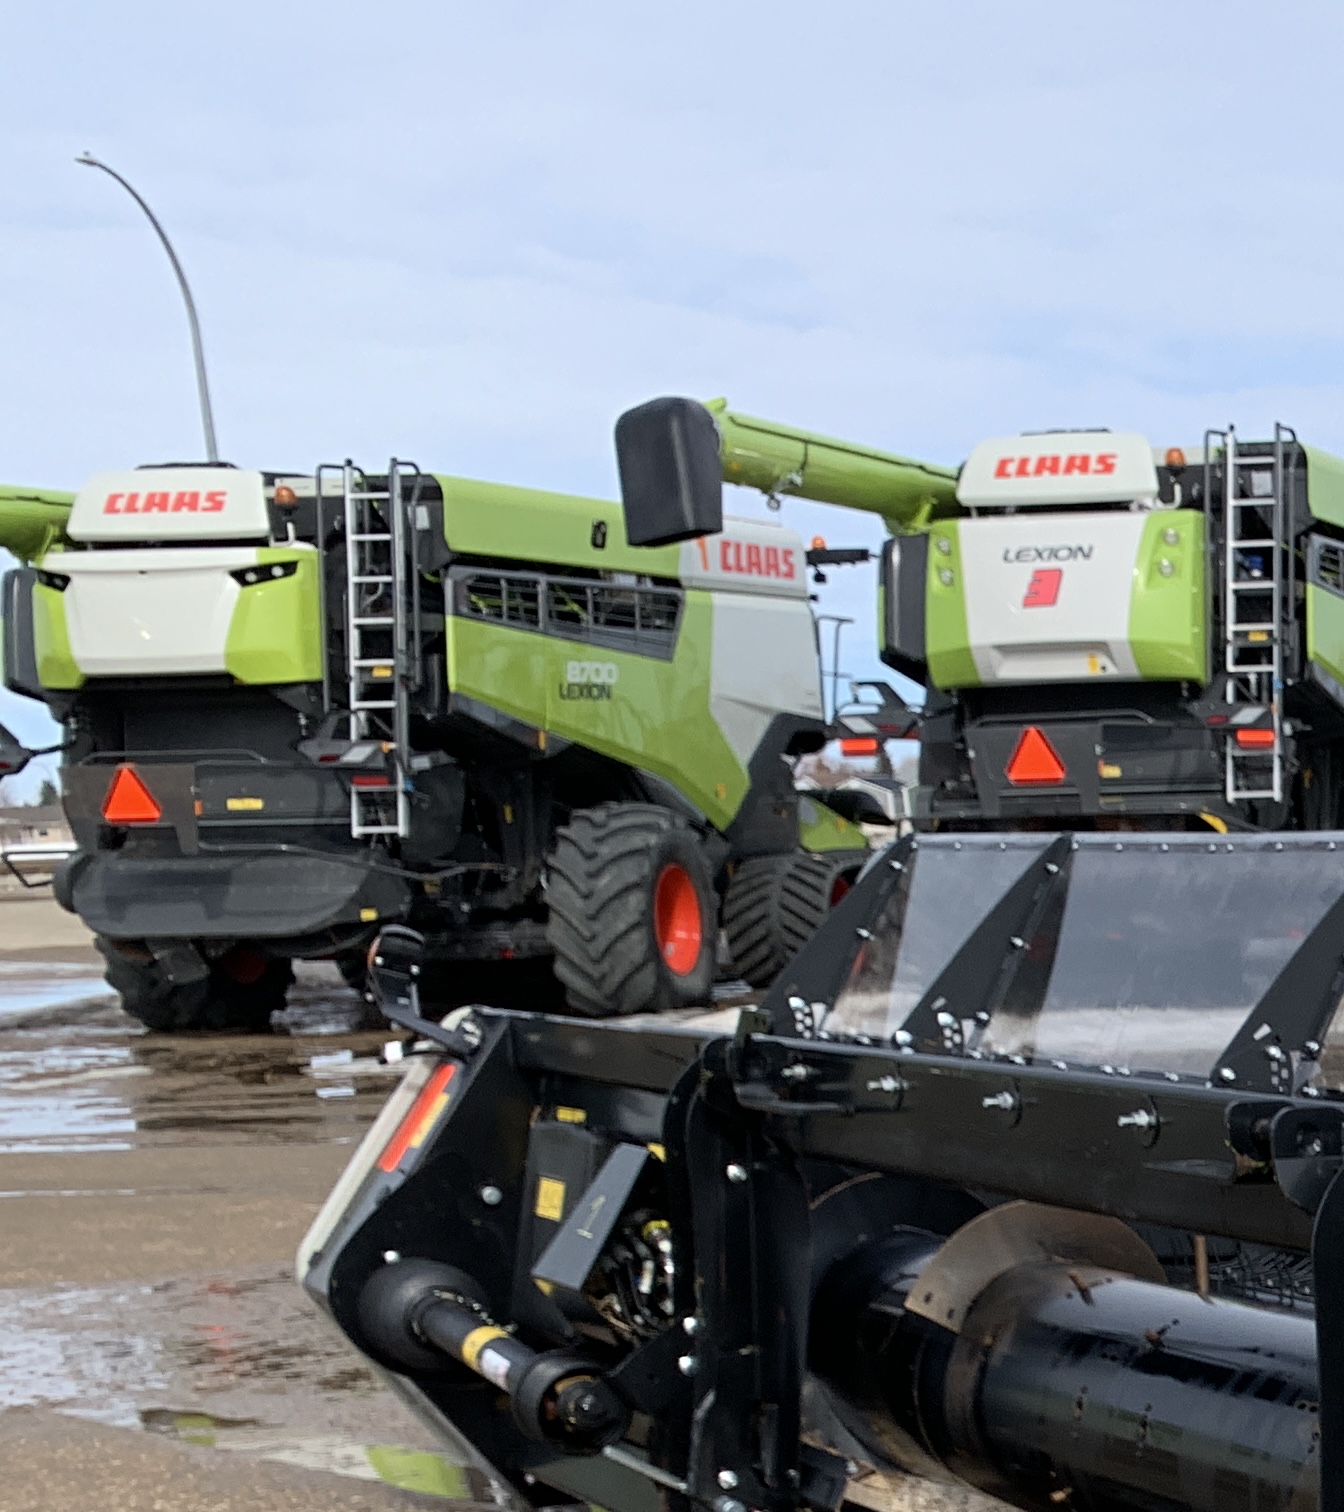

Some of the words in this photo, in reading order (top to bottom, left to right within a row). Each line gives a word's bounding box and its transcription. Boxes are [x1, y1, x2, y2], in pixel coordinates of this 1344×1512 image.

[994, 454, 1118, 480] CLAAS
[103, 491, 227, 515] CLAAS
[720, 540, 795, 579] CLAAS
[1003, 546, 1092, 563] LEXION
[566, 661, 618, 685] 8700
[559, 683, 612, 700] LEXION
